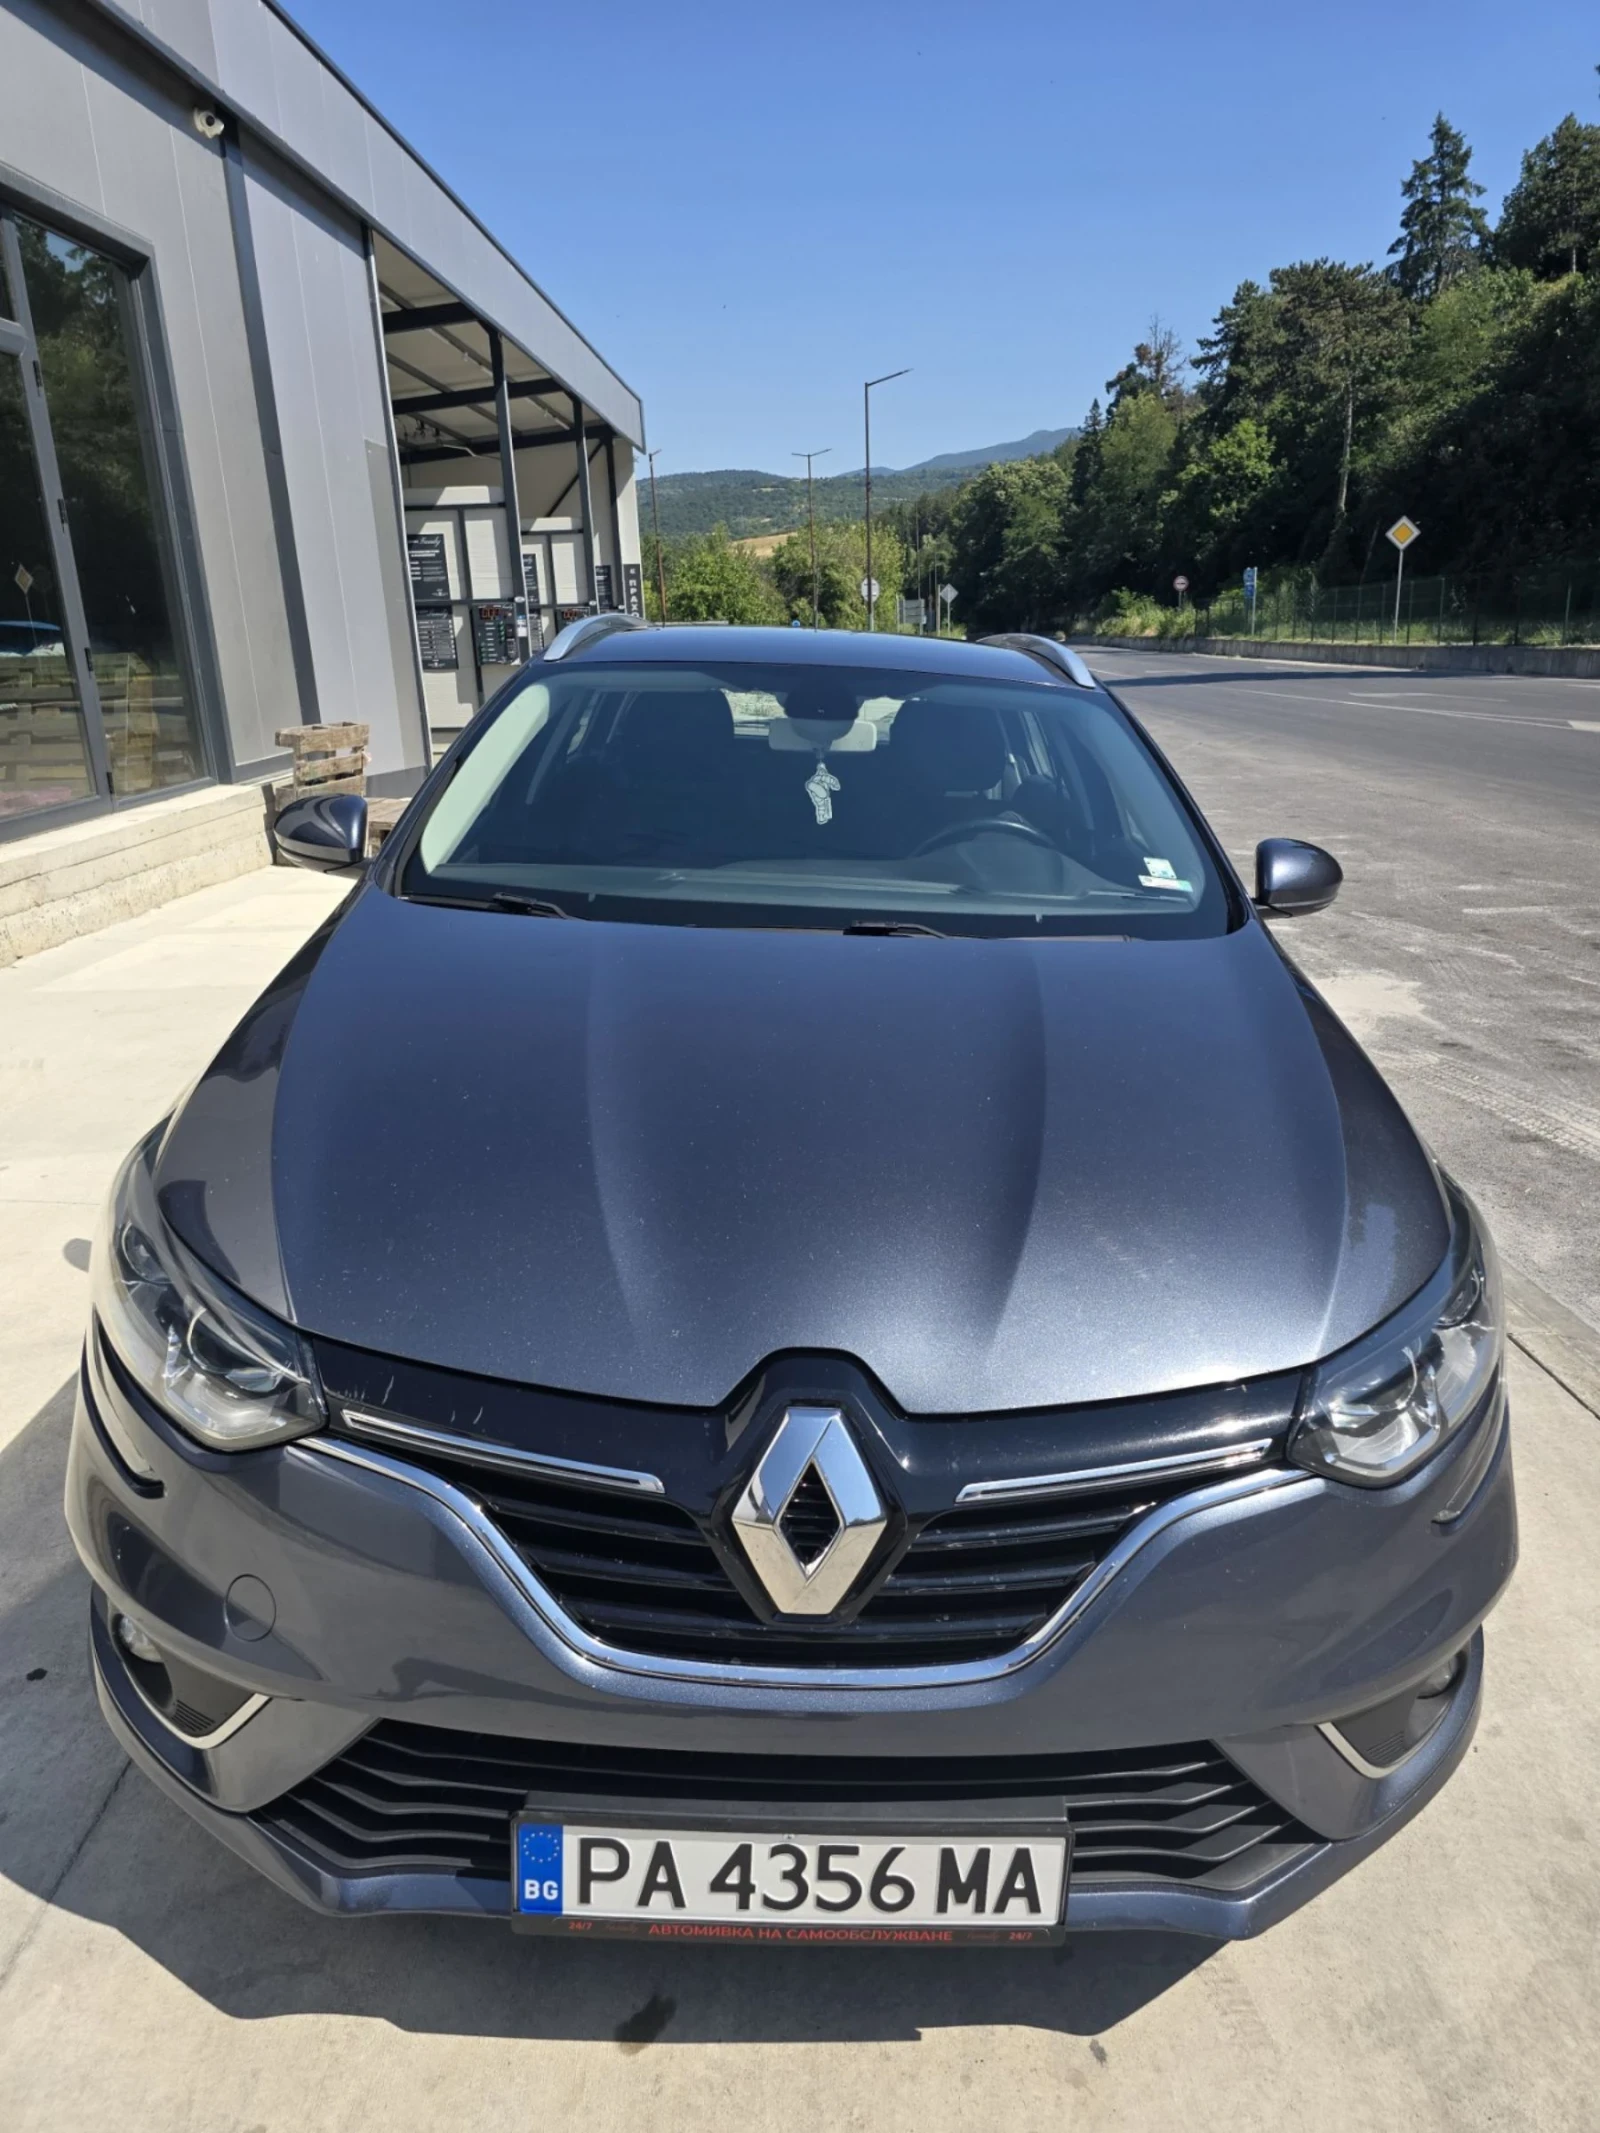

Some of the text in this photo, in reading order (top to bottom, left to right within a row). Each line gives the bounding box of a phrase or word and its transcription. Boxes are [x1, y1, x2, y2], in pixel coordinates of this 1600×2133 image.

[579, 1837, 1041, 1914] PA 4356 MA
[524, 1879, 559, 1901] BG
[568, 1921, 593, 1931] 24/7
[649, 1924, 754, 1938] АВТОМИВКА
[759, 1928, 782, 1939] НА
[786, 1928, 953, 1941] САМООБСЛУЖВАНЕ
[1009, 1931, 1033, 1941] 24/7
